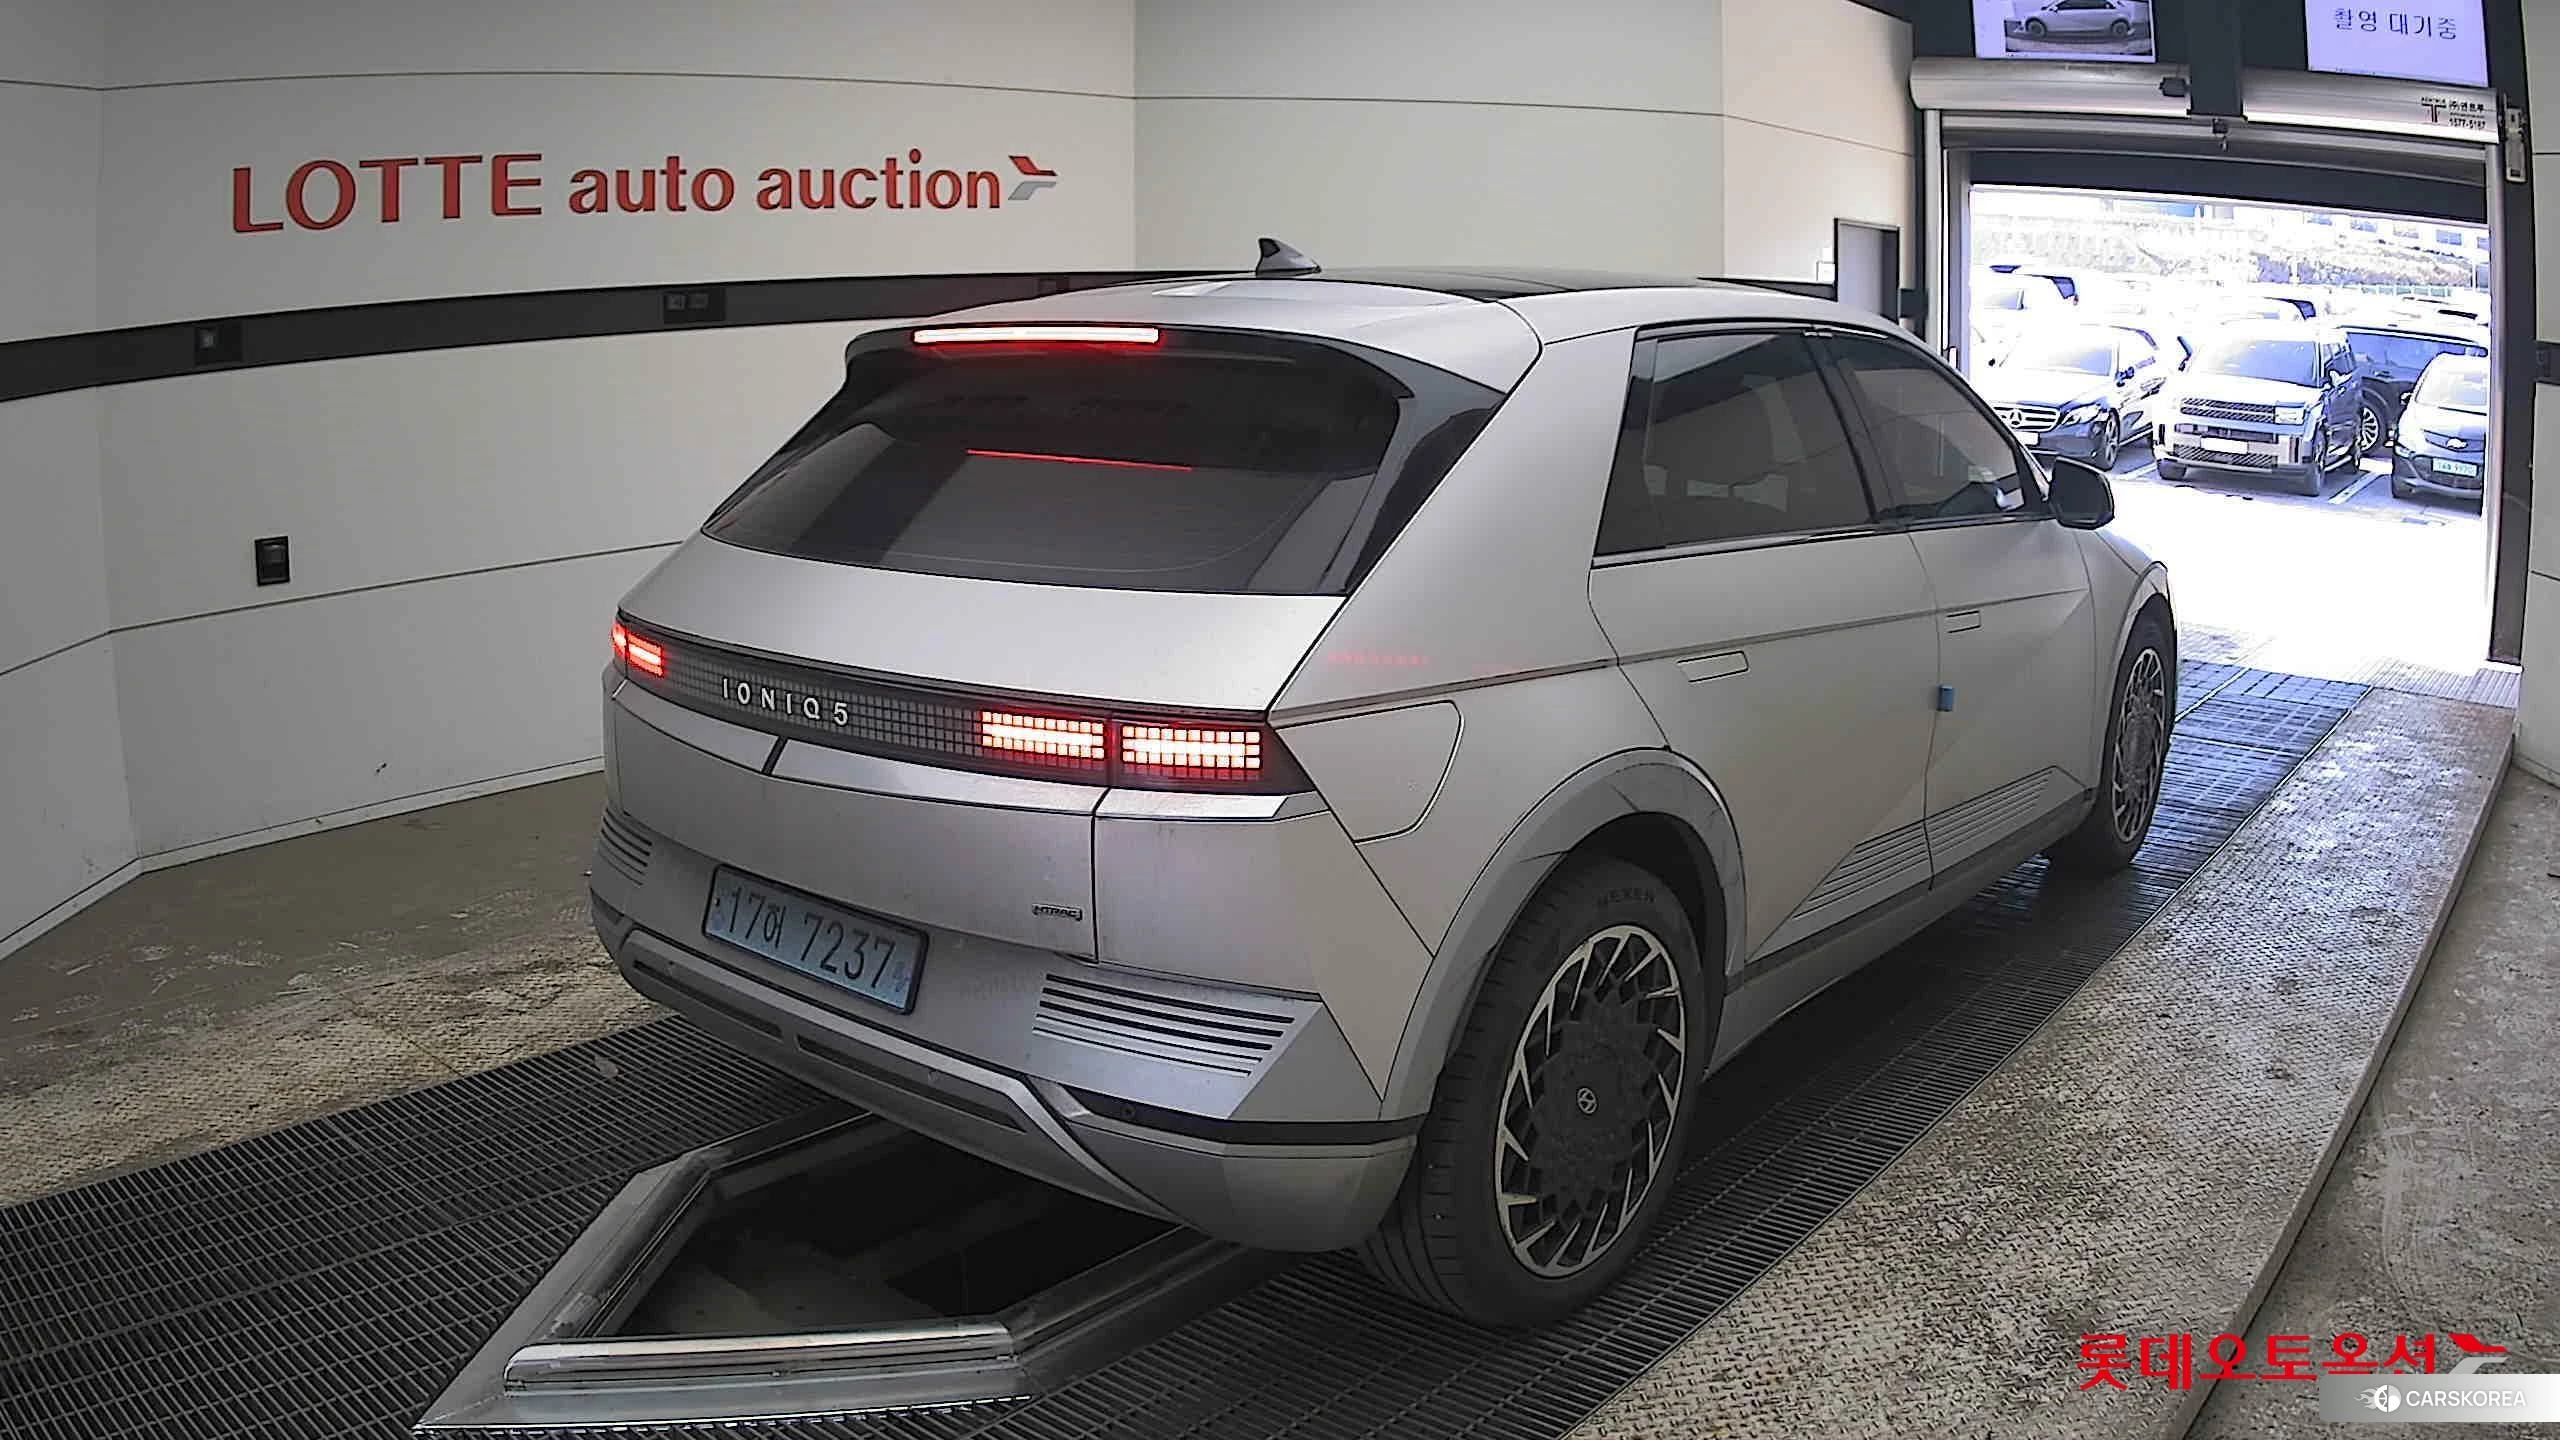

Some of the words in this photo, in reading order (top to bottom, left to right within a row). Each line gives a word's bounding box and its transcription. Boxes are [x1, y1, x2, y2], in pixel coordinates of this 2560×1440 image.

[2334, 8, 2377, 32] 촬영
[233, 153, 542, 233] LOTTE
[568, 155, 735, 214] auto
[757, 148, 1001, 210] auction
[800, 912, 897, 988] 7237
